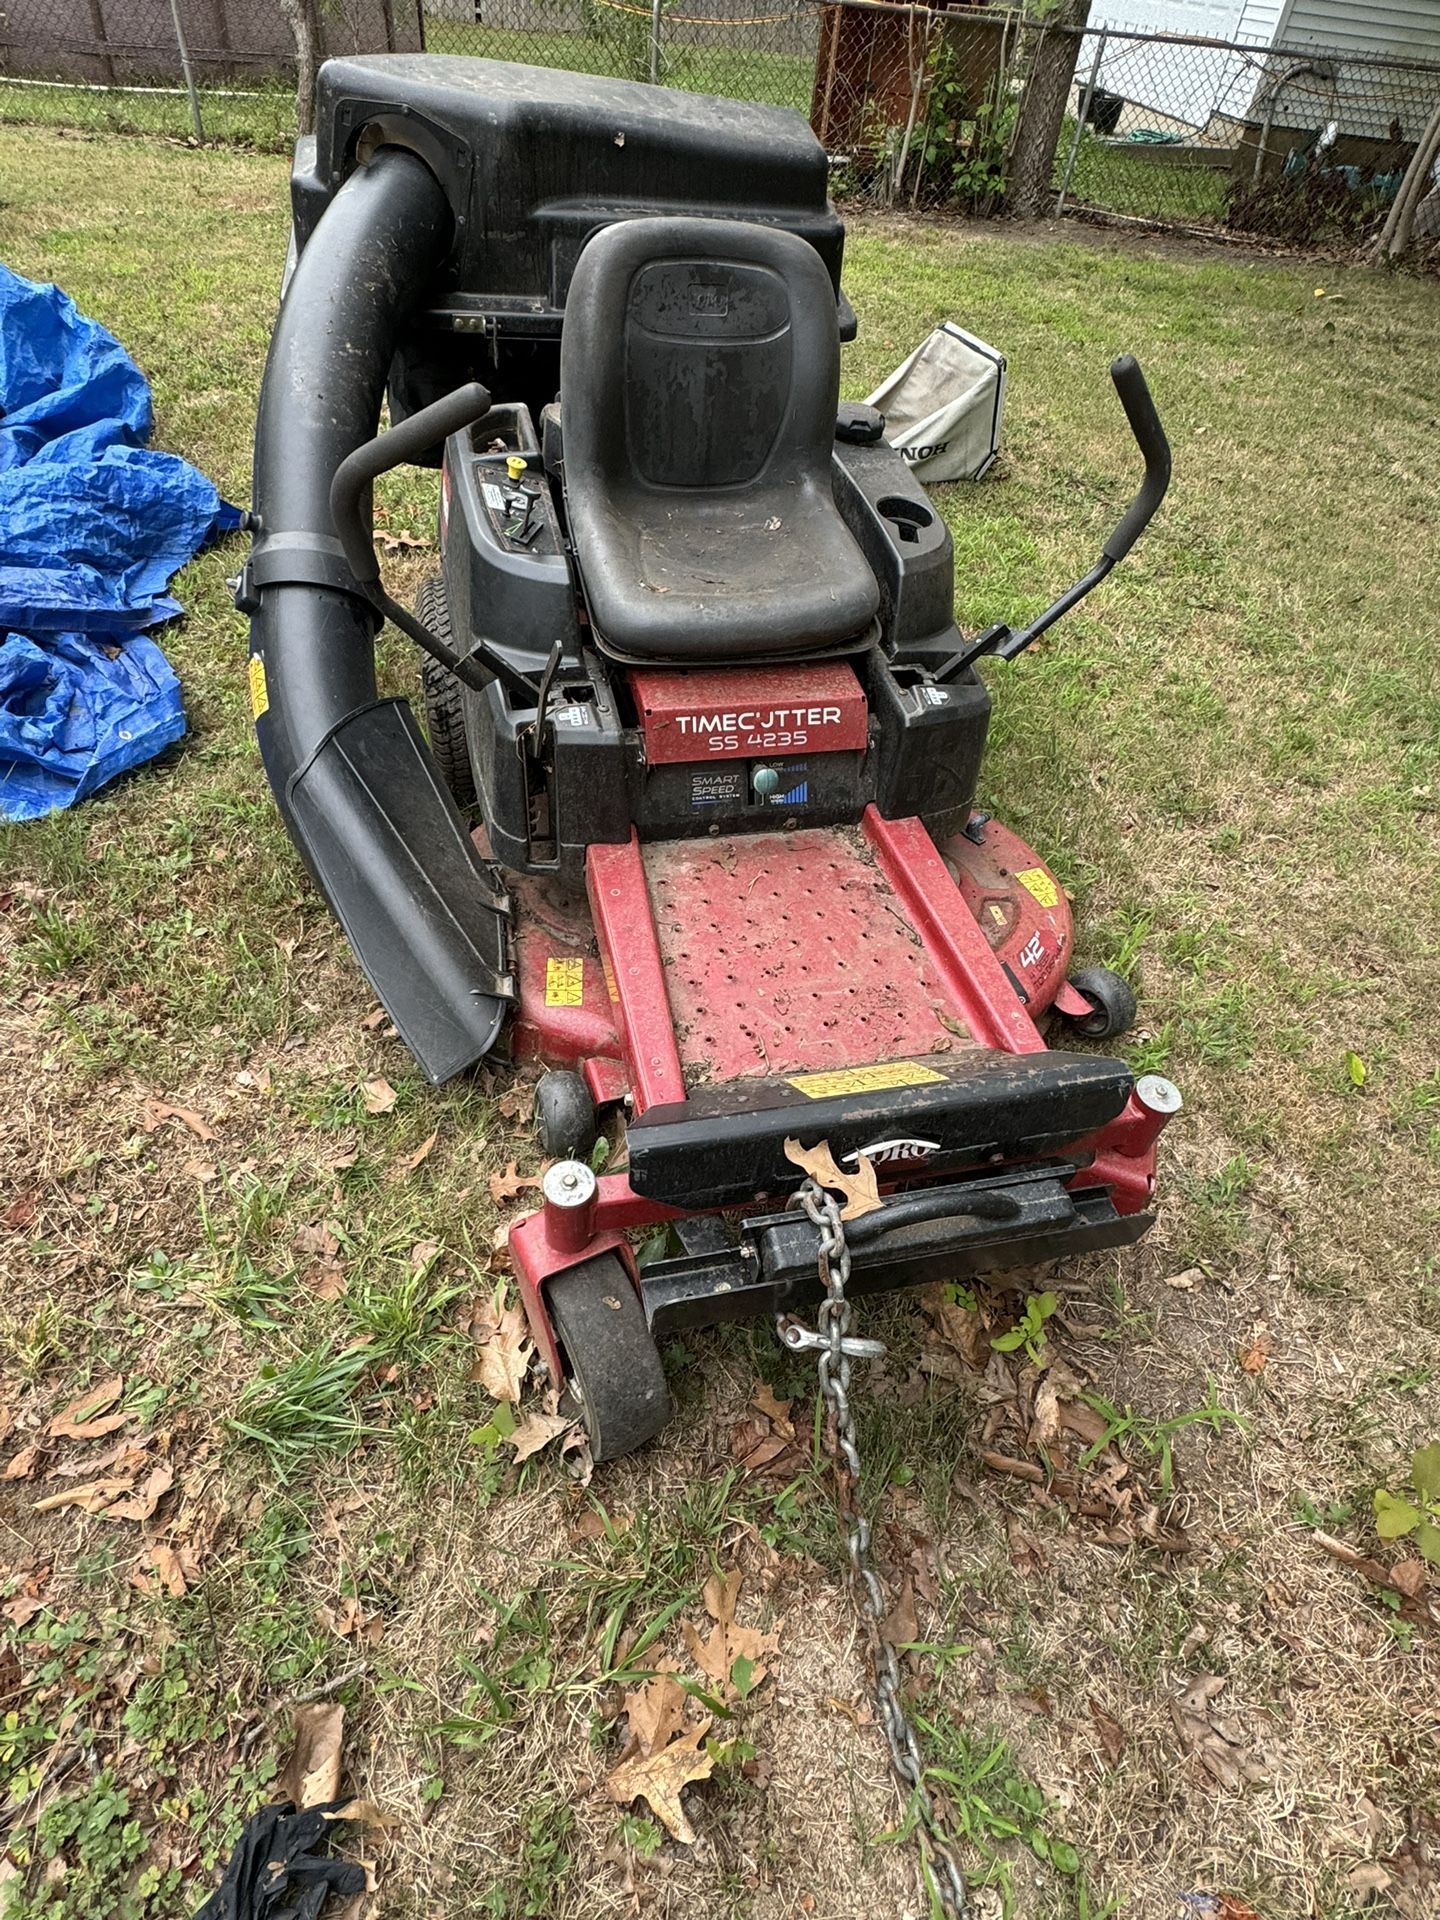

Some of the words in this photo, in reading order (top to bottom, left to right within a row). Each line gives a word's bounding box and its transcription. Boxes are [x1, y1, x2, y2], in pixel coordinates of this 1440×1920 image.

[708, 735, 739, 751] SS
[747, 730, 808, 748] 4235
[692, 774, 740, 786] SMART
[692, 785, 735, 796] SPEED
